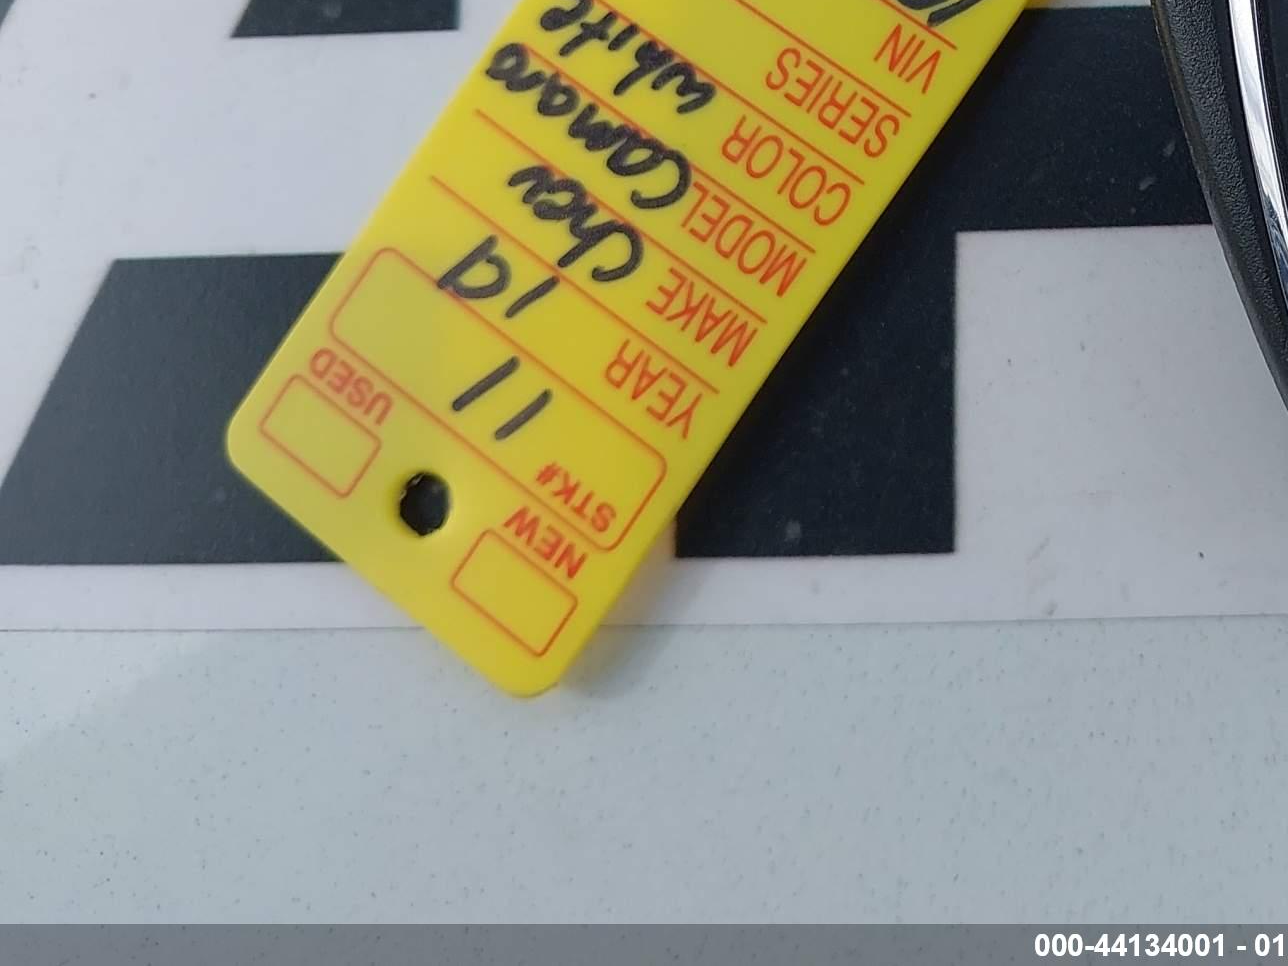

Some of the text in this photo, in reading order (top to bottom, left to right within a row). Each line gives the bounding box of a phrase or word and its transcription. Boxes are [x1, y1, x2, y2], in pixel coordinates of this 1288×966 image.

[765, 47, 900, 159] SERIES
[874, 23, 942, 94] VIN
[484, 42, 692, 210] Camaro
[721, 114, 851, 226] COLOR
[437, 235, 560, 318] 19
[681, 181, 807, 297] MODEL
[645, 267, 757, 367] MAKE
[309, 347, 394, 426] USED
[604, 339, 703, 439] YEAR
[503, 506, 587, 579] NEW
[536, 462, 617, 533] STK#
